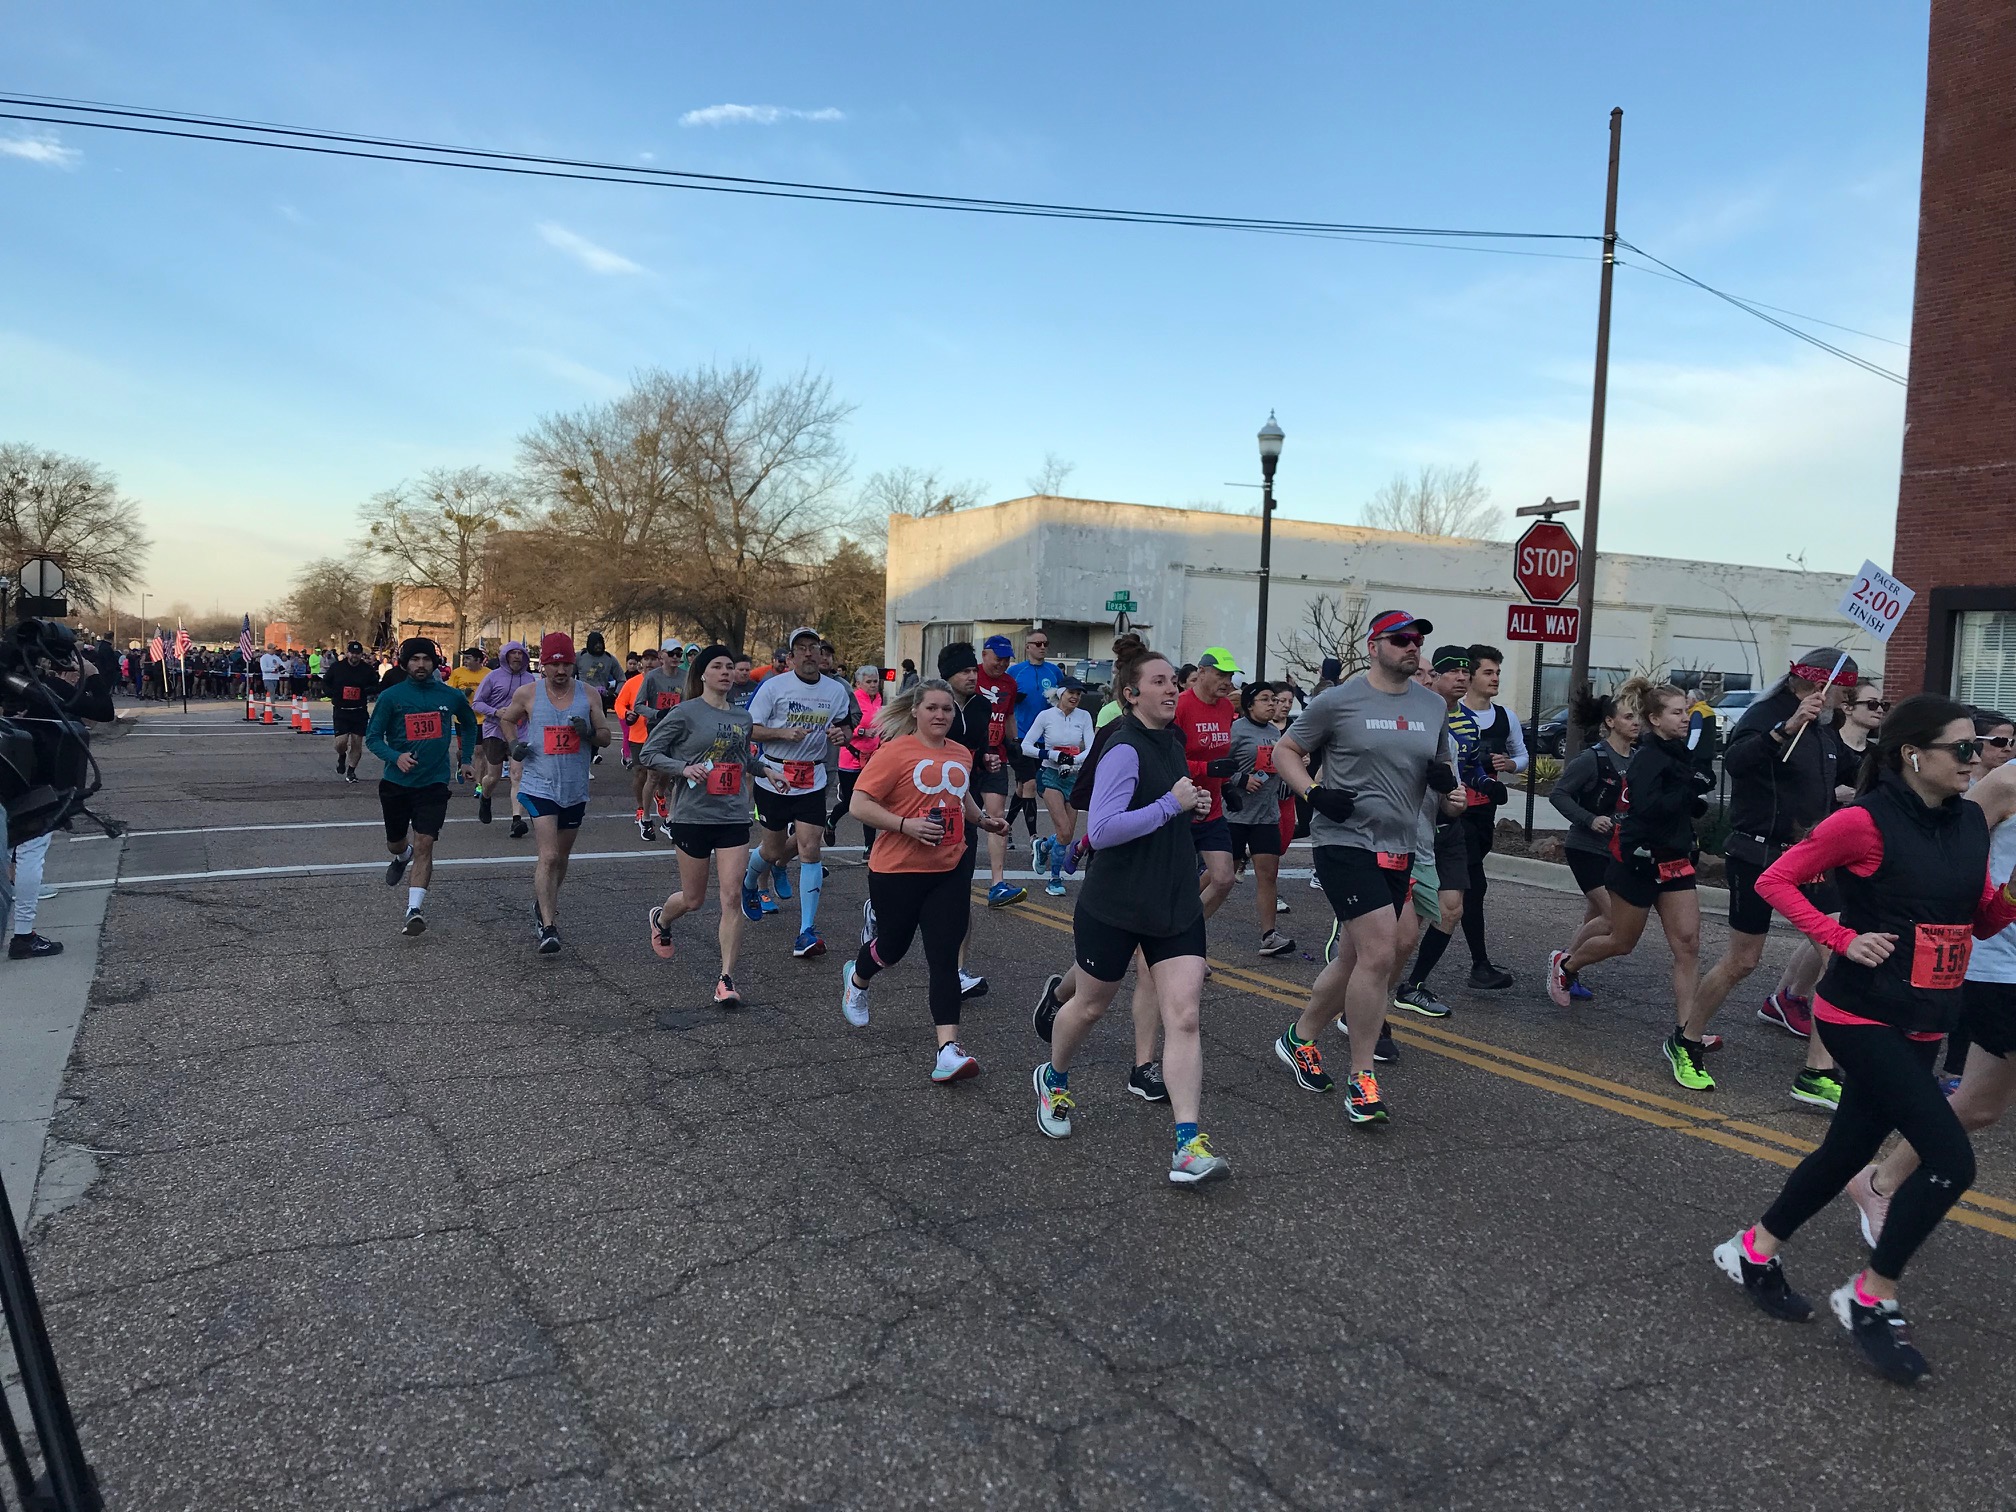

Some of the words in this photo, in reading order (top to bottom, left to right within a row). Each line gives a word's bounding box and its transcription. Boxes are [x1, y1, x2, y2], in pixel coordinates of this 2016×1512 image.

[1521, 546, 1574, 578] STOP
[1873, 571, 1900, 596] PACER
[1107, 601, 1127, 611] Texas
[1852, 577, 1900, 620] 2:00
[1509, 612, 1538, 634] ALL
[1545, 614, 1577, 636] WAY
[1848, 602, 1885, 633] FINISH
[413, 720, 435, 733] 330
[1196, 723, 1219, 732] TEAM
[1365, 715, 1426, 731] IRONMAN
[556, 734, 570, 747] 12
[720, 773, 733, 787] 49
[793, 769, 806, 782] 75
[1921, 927, 1945, 936] RUN
[1933, 942, 1966, 972] 159
